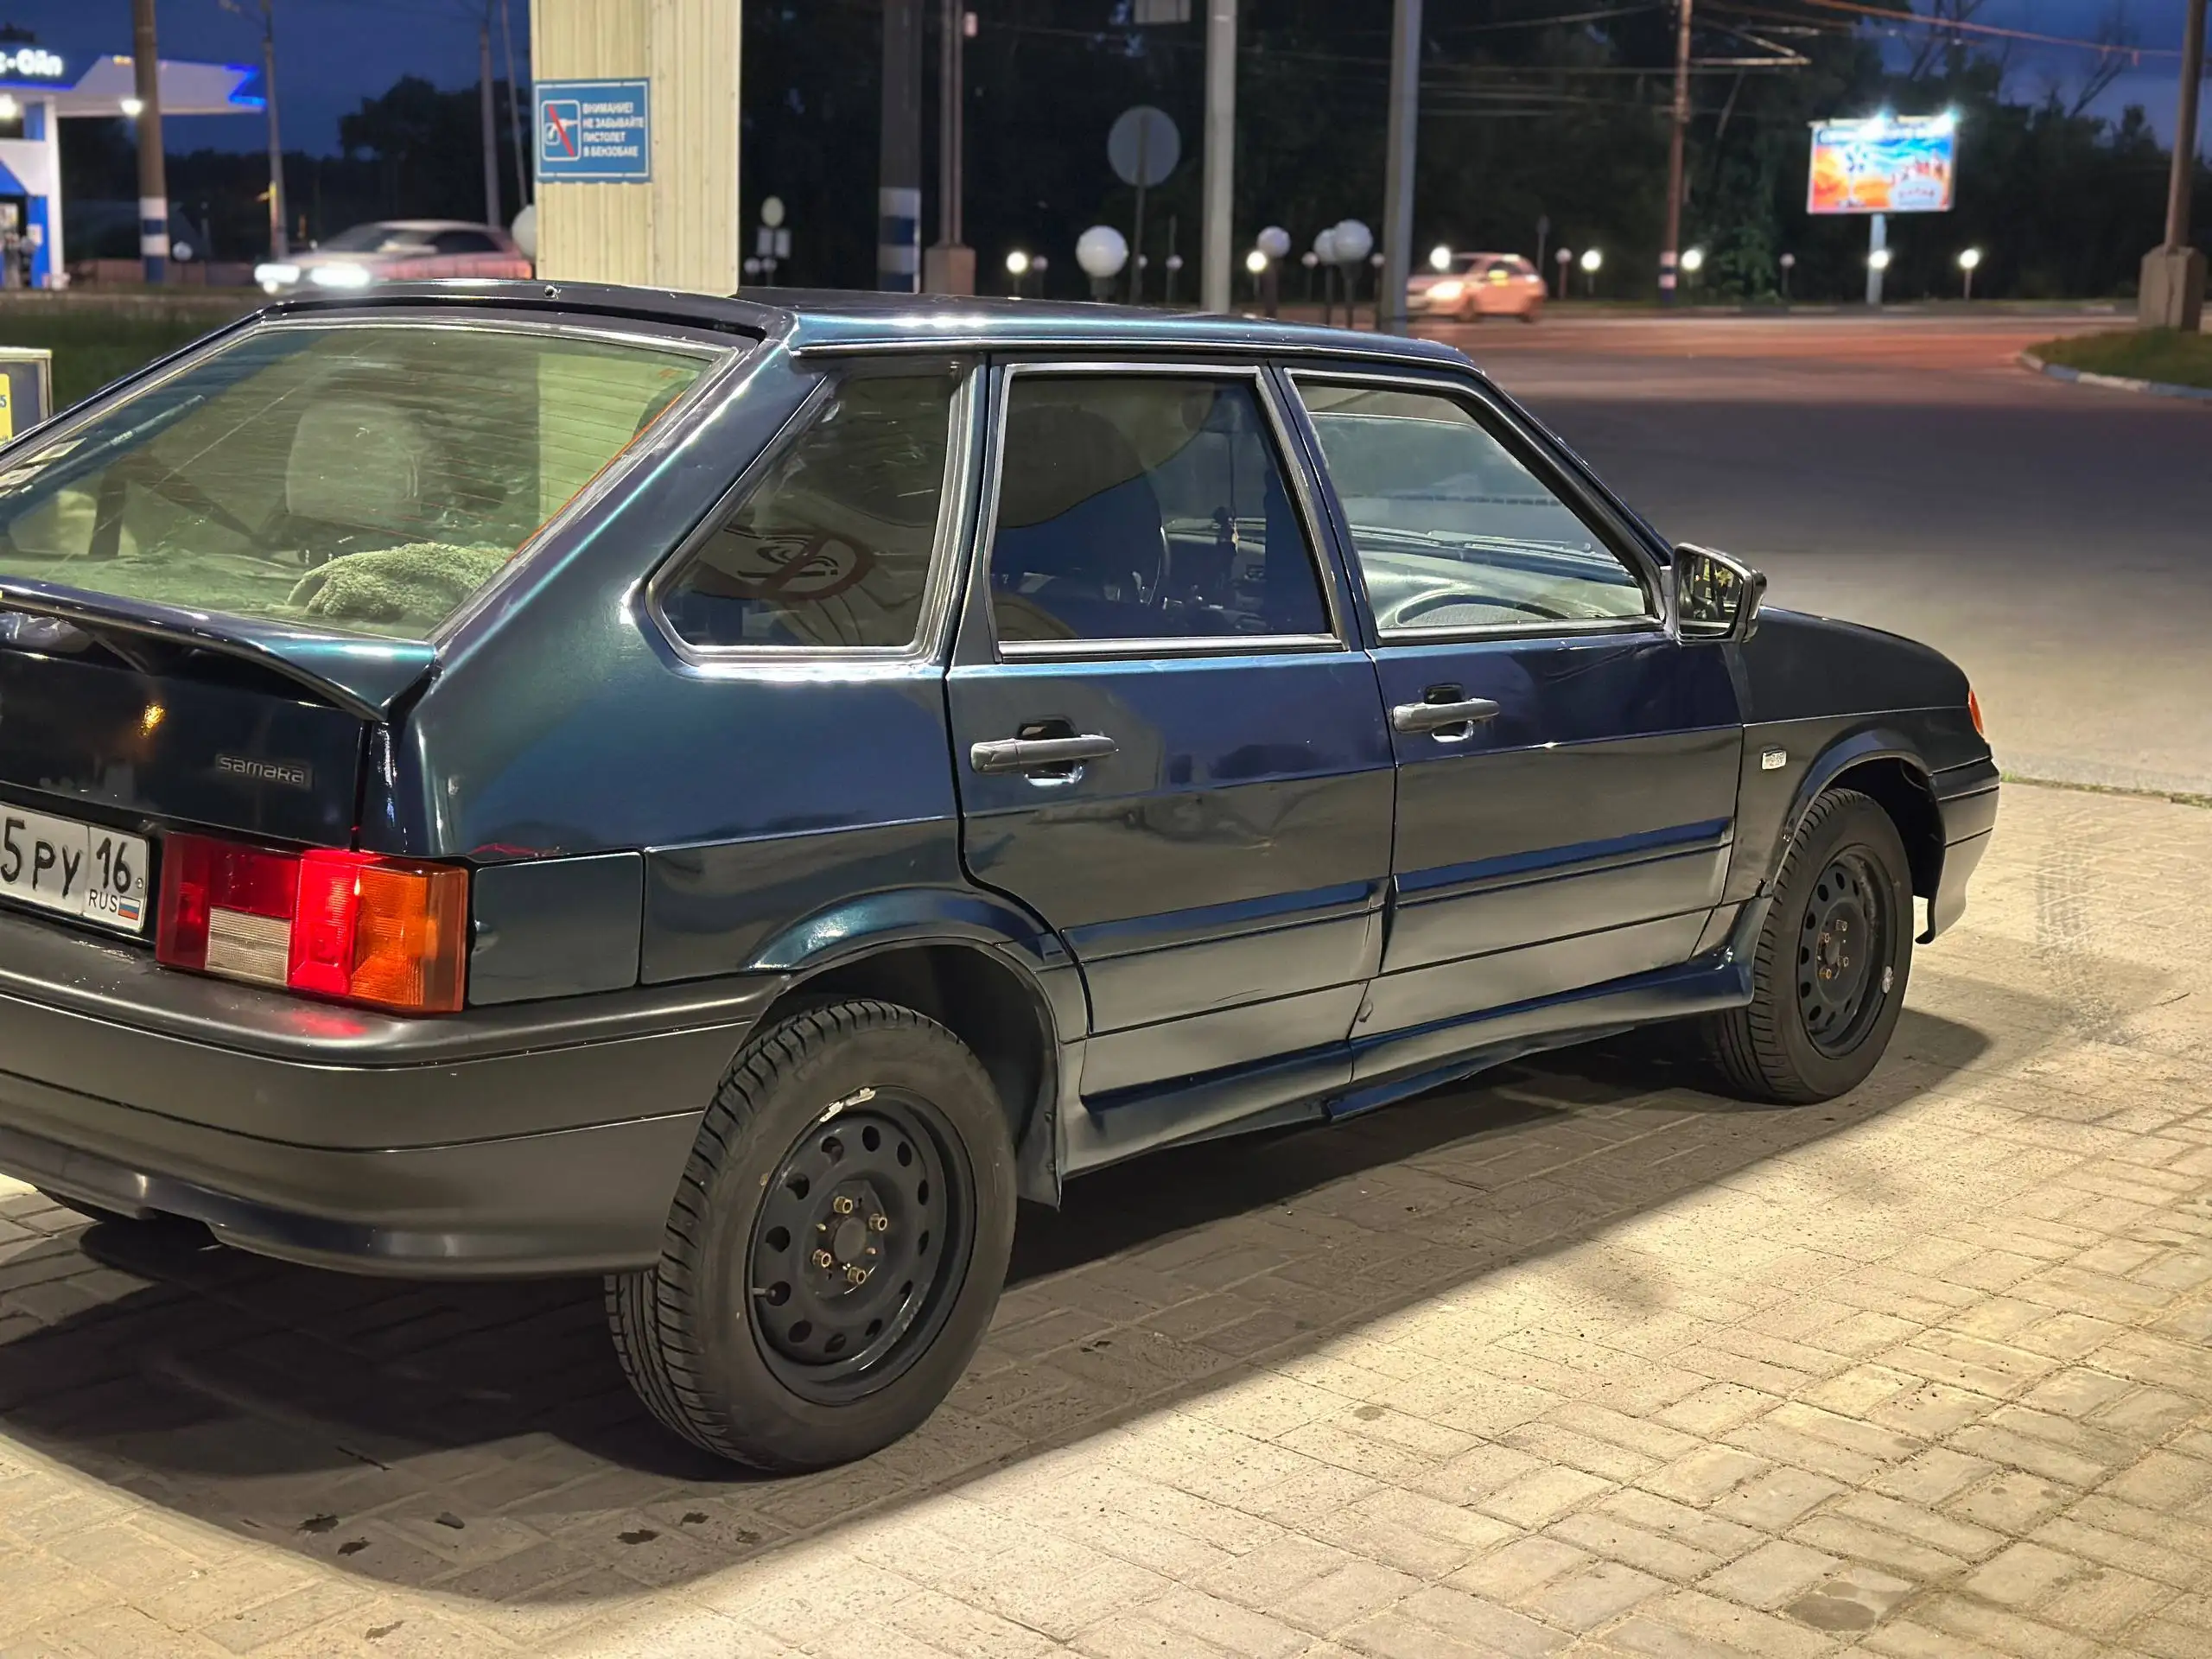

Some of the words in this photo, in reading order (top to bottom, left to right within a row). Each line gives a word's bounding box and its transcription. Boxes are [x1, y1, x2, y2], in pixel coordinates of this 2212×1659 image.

[582, 101, 633, 114] ВНИМАНИЕ!
[582, 118, 593, 129] НЕ
[595, 115, 645, 129] ЗАБЫВАЙТЕ
[583, 131, 626, 143] ПИСТОЛЕТ
[590, 146, 639, 157] БЕНЗОБАКЕ
[96, 836, 131, 894] 16
[88, 888, 118, 913] RUS
